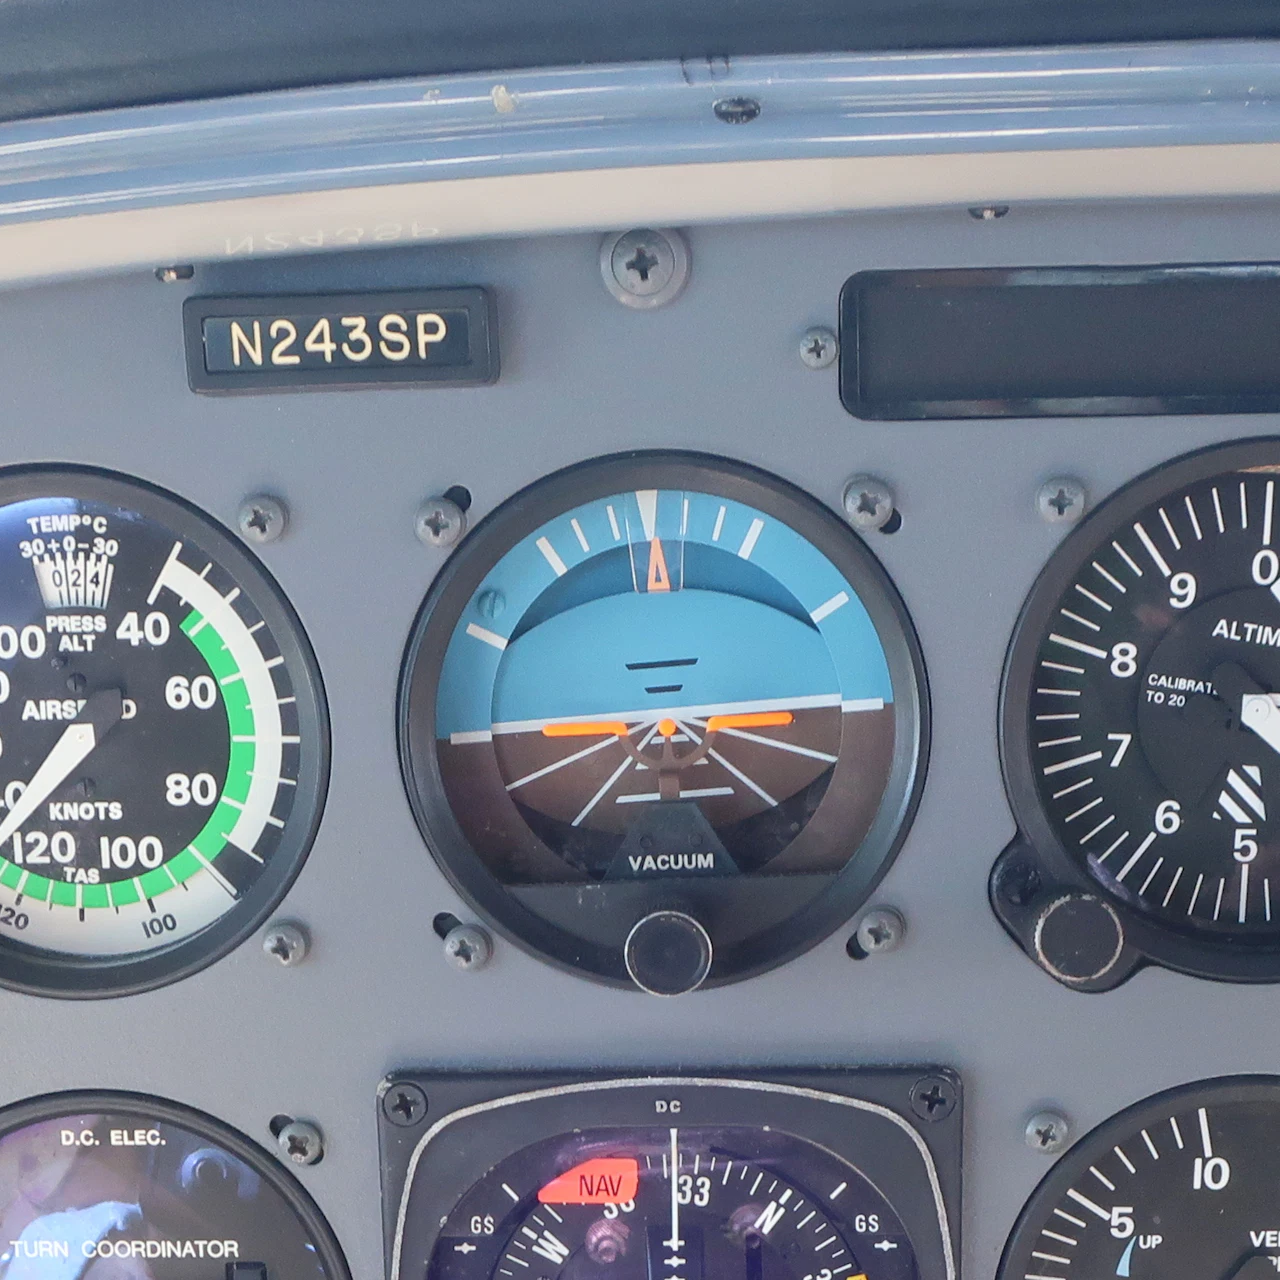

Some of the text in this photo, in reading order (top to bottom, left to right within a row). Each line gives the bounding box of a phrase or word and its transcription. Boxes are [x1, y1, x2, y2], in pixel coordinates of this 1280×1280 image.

[230, 313, 447, 366] N243SP
[45, 615, 107, 633] PRESS
[115, 611, 170, 647] 40
[58, 634, 96, 652] ALT
[165, 675, 217, 710] 60
[49, 801, 123, 821] KNOTS
[628, 853, 714, 872] VACUUM
[63, 866, 100, 885] TAS
[110, 1129, 166, 1146] ELEC.
[579, 1174, 622, 1197] NAV
[470, 1214, 495, 1235] GS
[855, 1214, 879, 1233] GS
[10, 1241, 239, 1258] TURN COORDINATOR
[1138, 1234, 1163, 1250] UP
